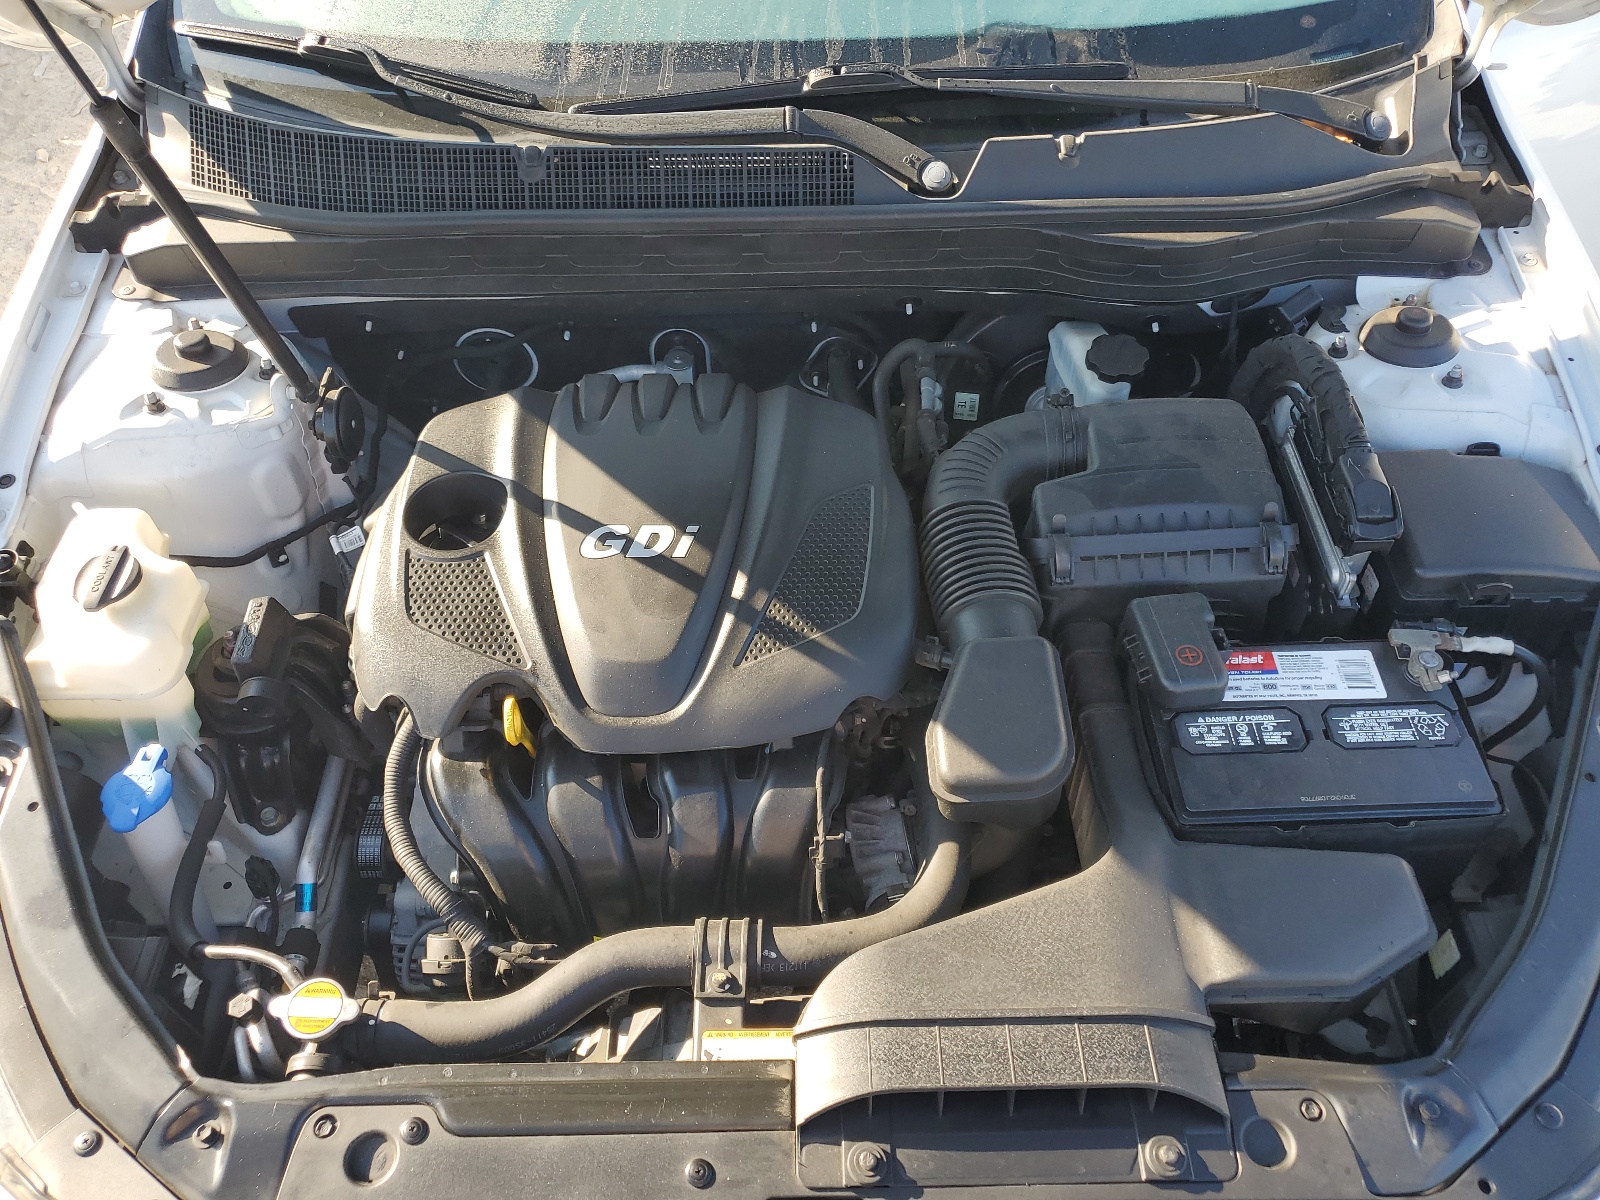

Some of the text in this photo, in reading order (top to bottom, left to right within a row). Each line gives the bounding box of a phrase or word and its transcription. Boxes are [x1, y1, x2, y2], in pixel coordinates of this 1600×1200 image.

[579, 523, 702, 559] GDi
[91, 555, 115, 593] COOLANT
[1205, 715, 1238, 723] DANGER
